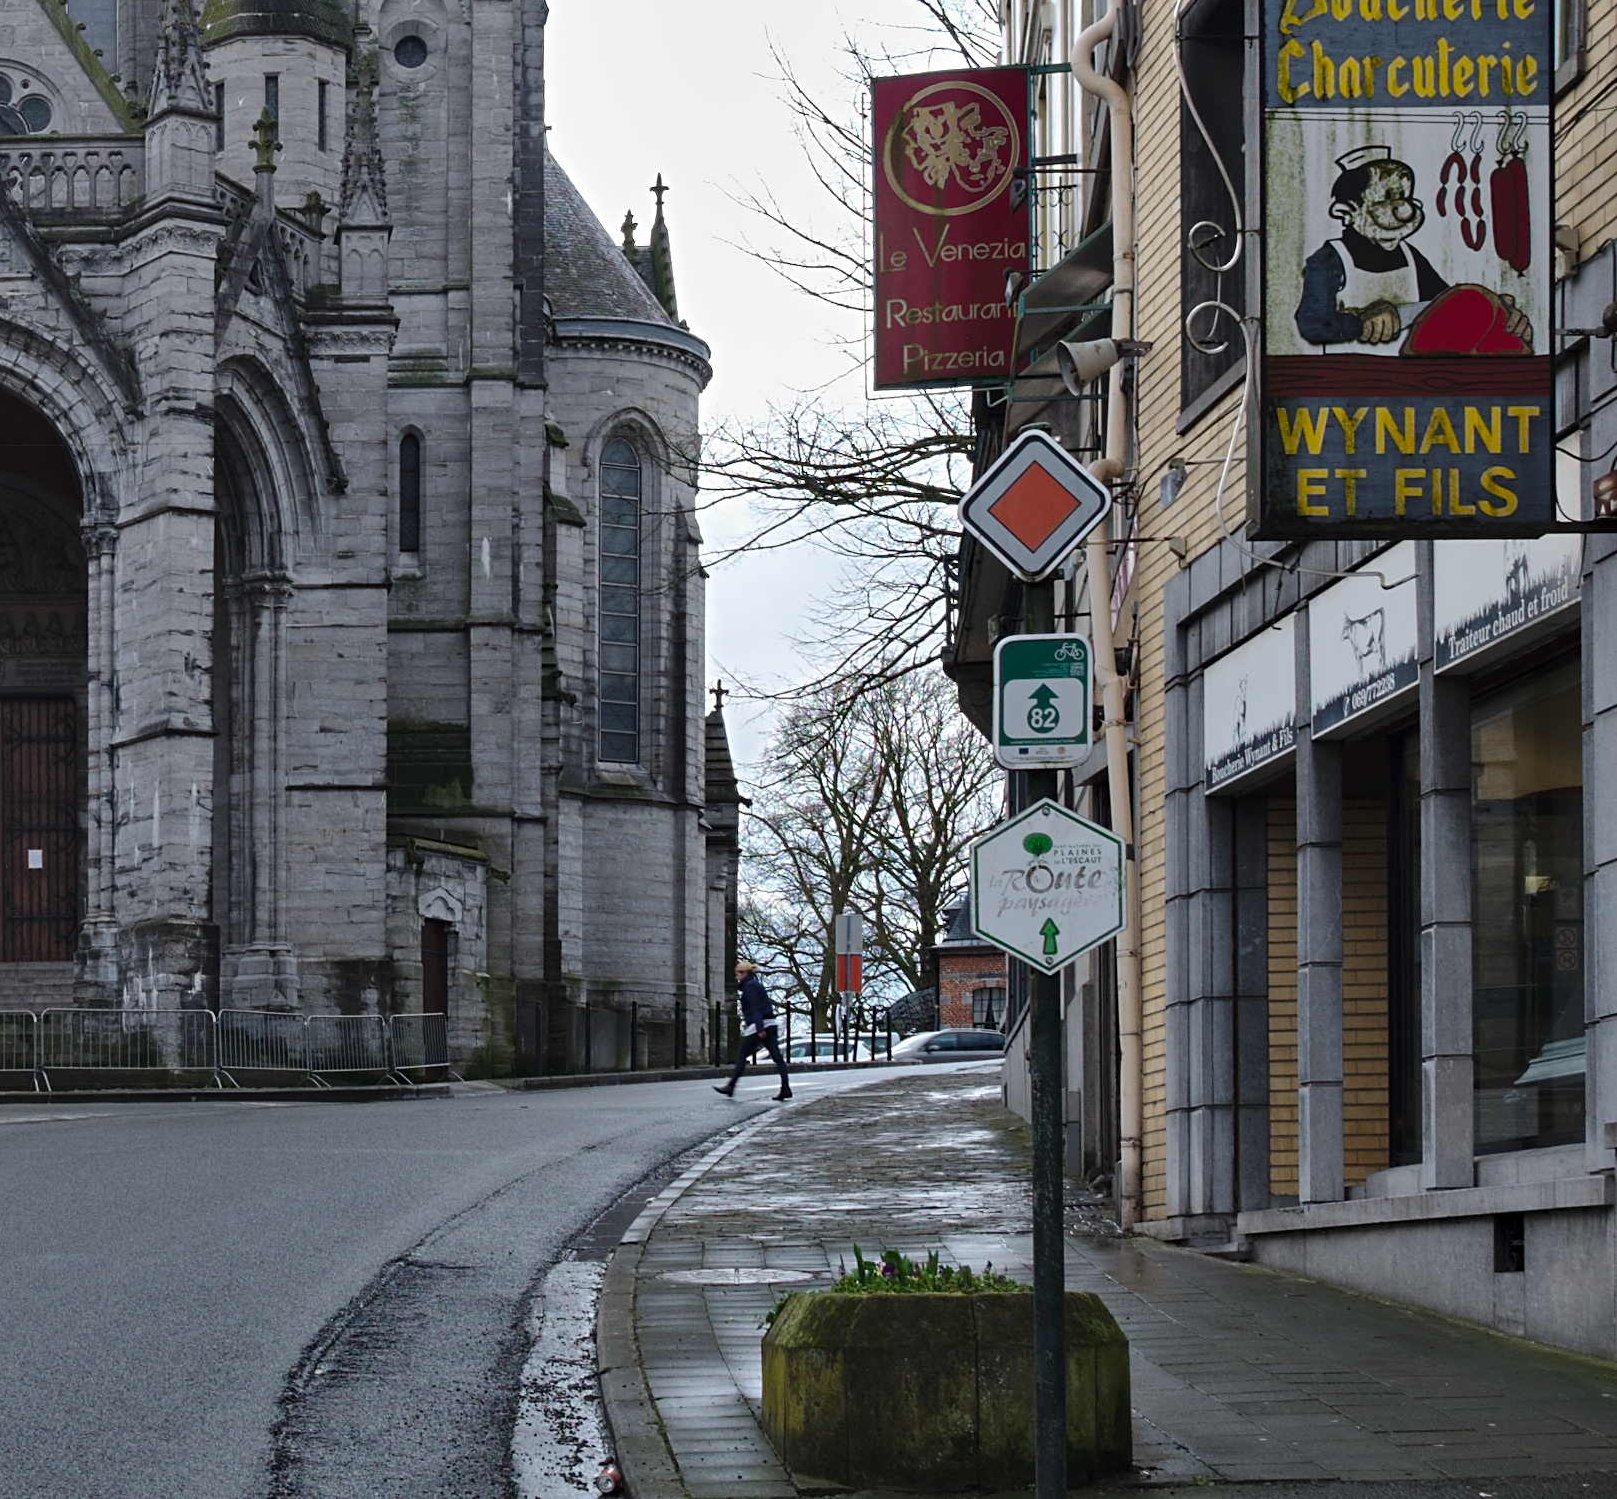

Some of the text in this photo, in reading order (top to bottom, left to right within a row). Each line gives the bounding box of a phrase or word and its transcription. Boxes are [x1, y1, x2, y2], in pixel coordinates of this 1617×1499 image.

[1277, 37, 1538, 104] Charcuterie
[879, 223, 1026, 273] Le Venezia
[903, 343, 1005, 374] Pizzeria
[1276, 405, 1541, 455] WYNANT
[1297, 465, 1518, 517] ET FILS
[1448, 575, 1569, 659] Traiteur chaud et froid
[1030, 707, 1056, 729] 82
[1211, 726, 1294, 784] Boucherie Wynant & Fils
[1053, 848, 1102, 856] PLAINES
[1061, 856, 1102, 865] L'ESCAUT
